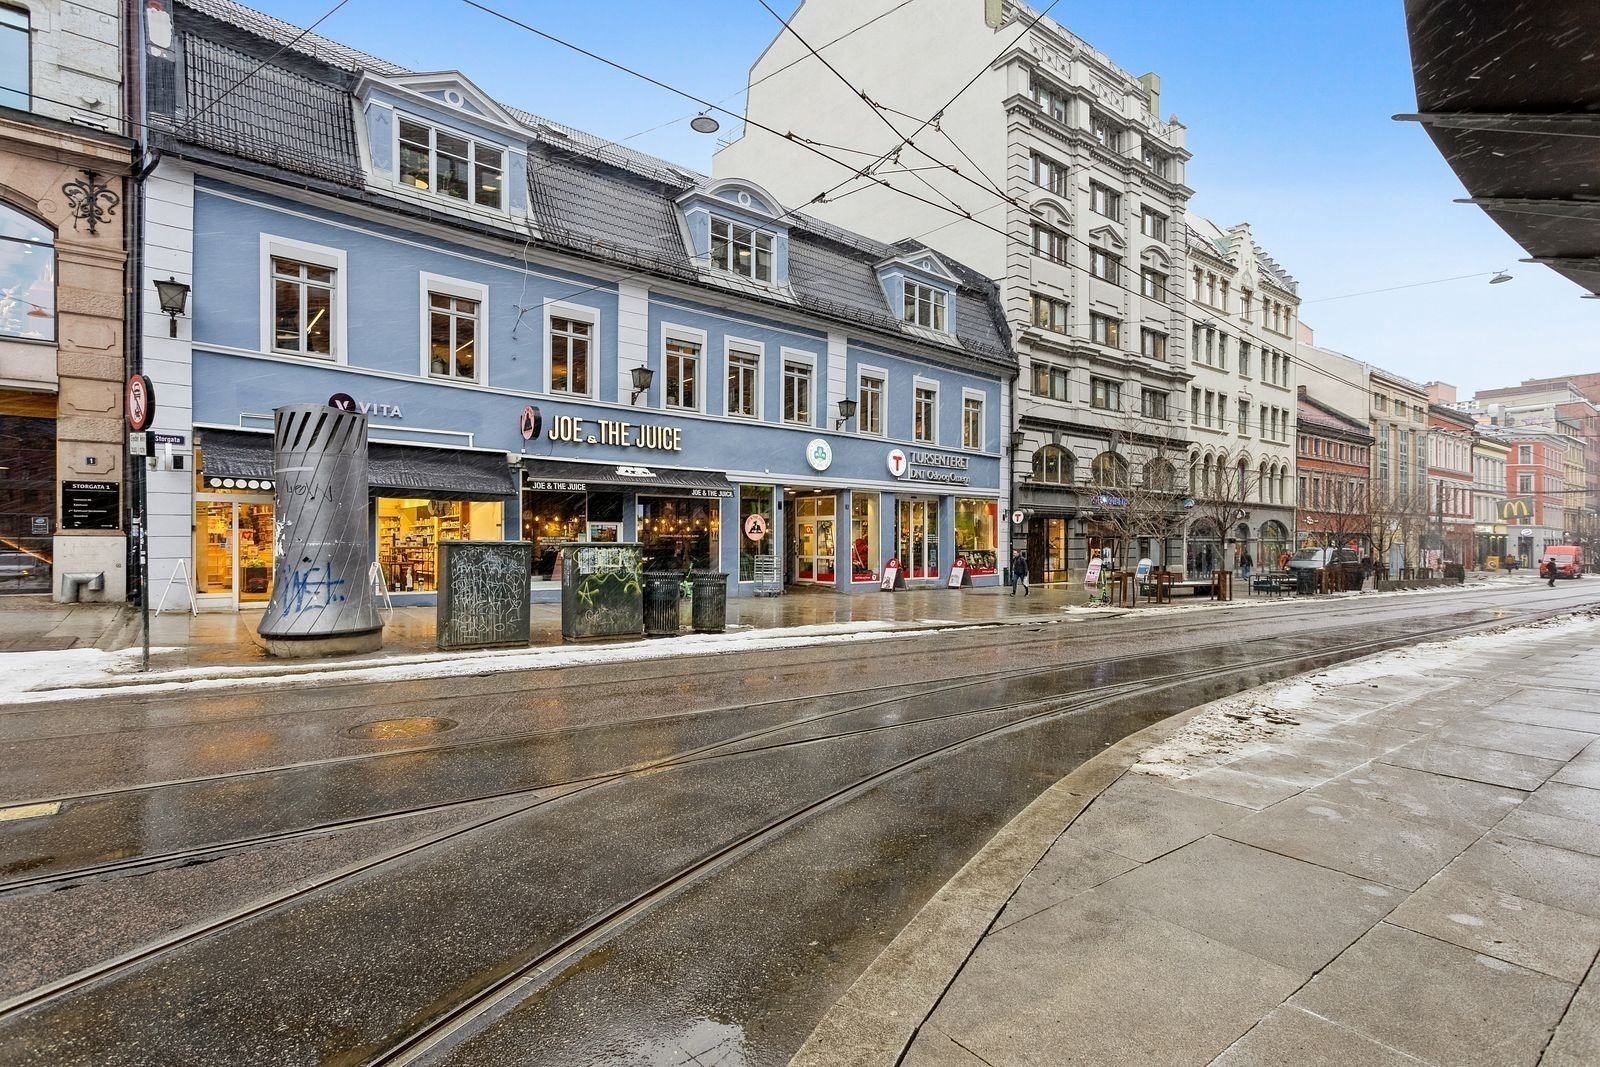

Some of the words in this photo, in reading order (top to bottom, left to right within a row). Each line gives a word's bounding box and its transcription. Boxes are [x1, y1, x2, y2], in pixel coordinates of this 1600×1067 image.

[359, 402, 402, 418] VITA
[155, 435, 180, 444] Storgata
[549, 416, 583, 442] JOE
[587, 436, 597, 444] &
[598, 419, 630, 446] THE
[636, 424, 682, 450] JUICE
[910, 452, 970, 468] TURSENTERET
[910, 469, 925, 479] DNT
[927, 470, 941, 480] Oslo
[942, 474, 949, 483] og
